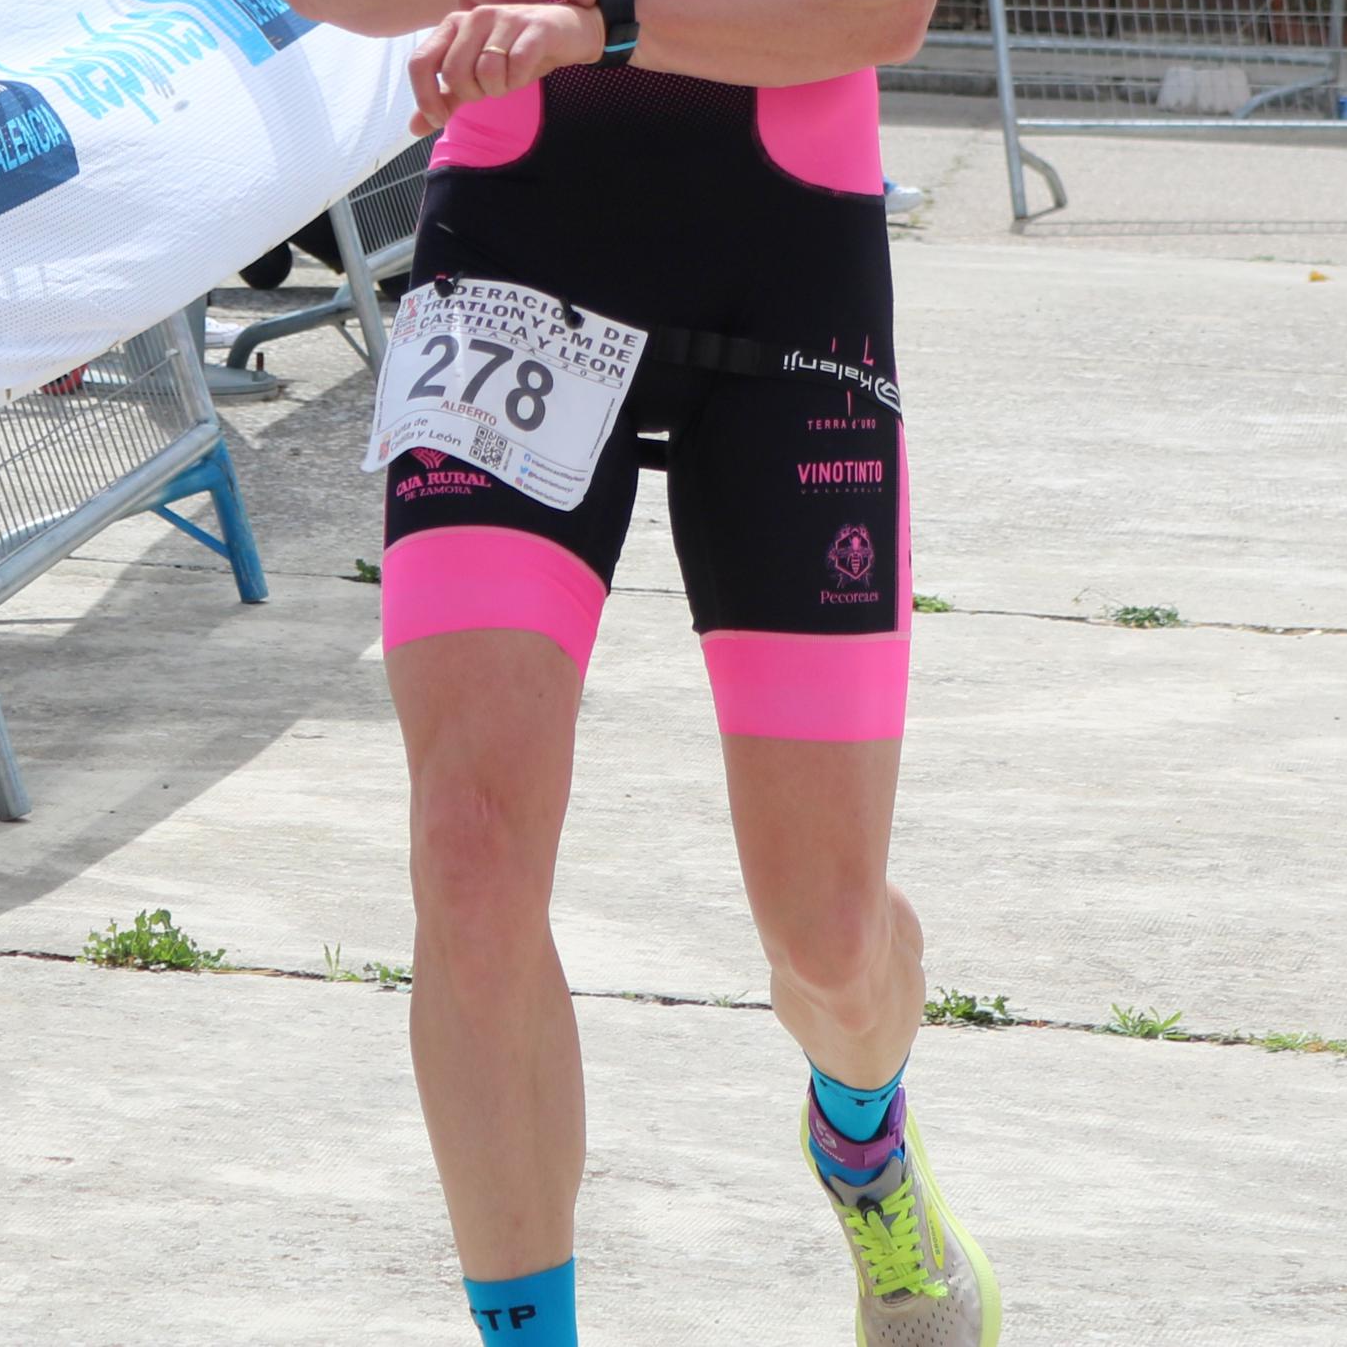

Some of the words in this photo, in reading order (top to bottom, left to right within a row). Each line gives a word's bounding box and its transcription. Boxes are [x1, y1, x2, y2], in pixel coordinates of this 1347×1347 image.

[427, 284, 586, 329] FDERACIO
[604, 326, 639, 348] DE
[423, 299, 525, 322] TRIATLON
[532, 316, 545, 329] Y
[599, 343, 633, 364] DE
[420, 313, 528, 341] CASTILLA
[538, 336, 552, 350] Y
[559, 346, 626, 379] LEON
[406, 335, 554, 433] 278
[783, 351, 873, 391] kalenji
[441, 400, 498, 427] ALBERTO
[807, 420, 847, 431] TERRA
[428, 430, 462, 446] León
[396, 475, 424, 497] CAJA
[427, 472, 492, 488] RURAL
[797, 460, 883, 484] VINOTINTO
[419, 484, 472, 497] ZAMORA
